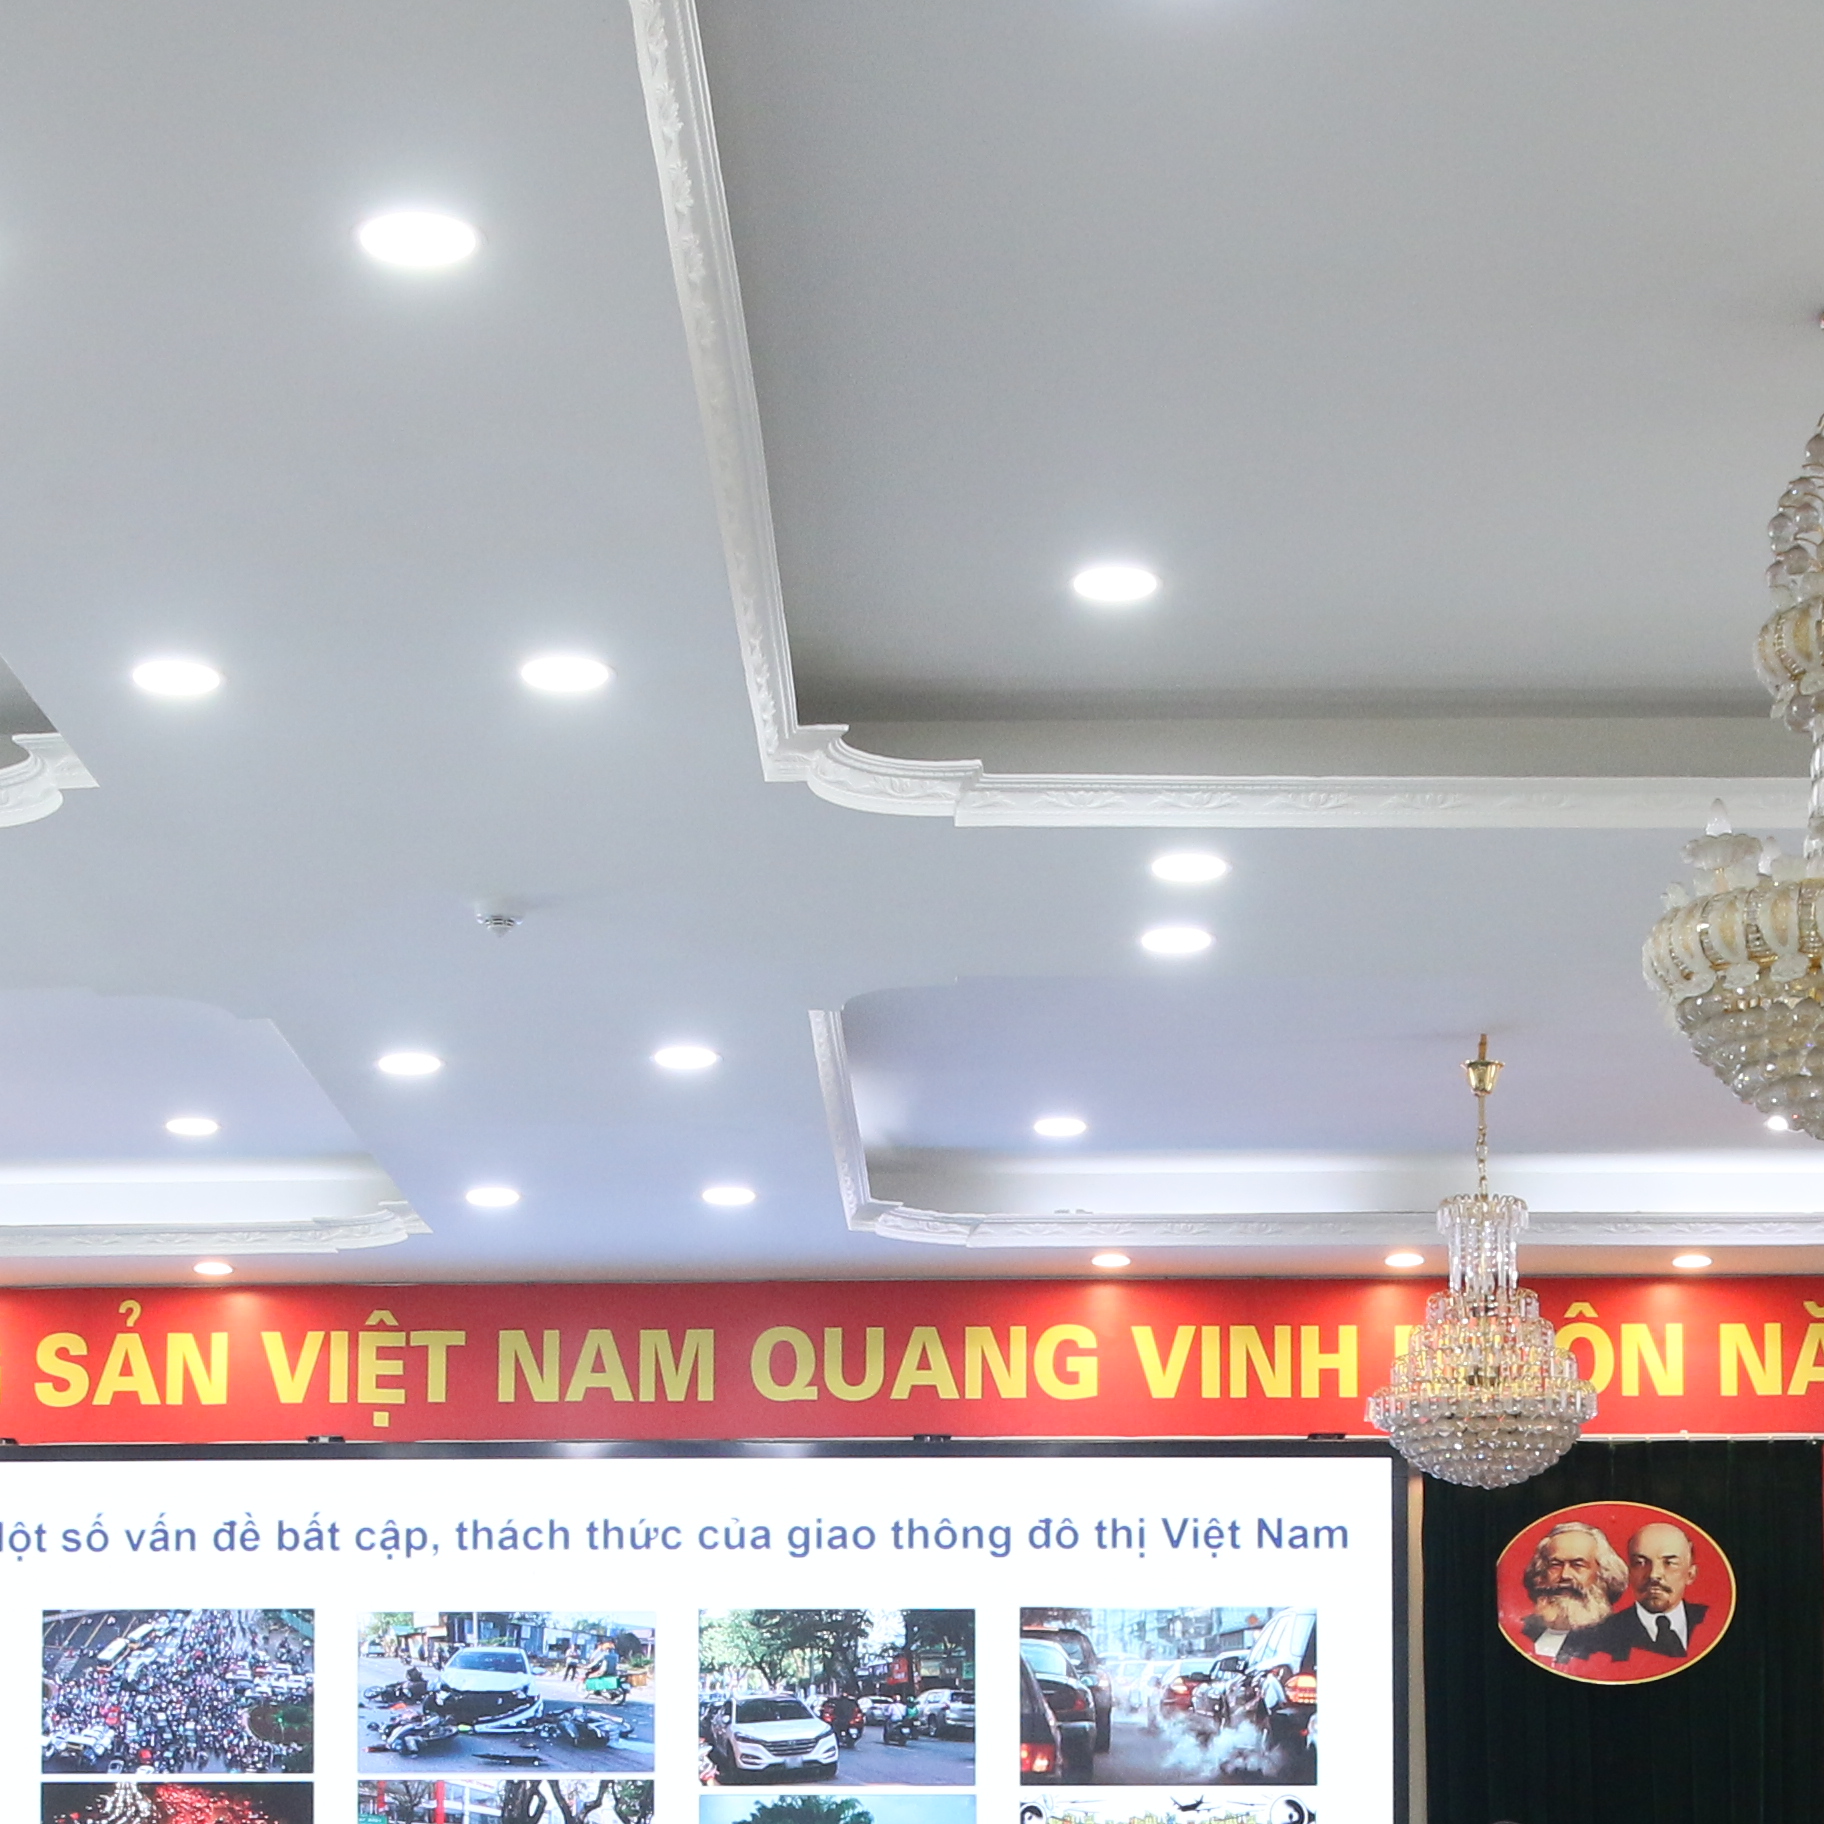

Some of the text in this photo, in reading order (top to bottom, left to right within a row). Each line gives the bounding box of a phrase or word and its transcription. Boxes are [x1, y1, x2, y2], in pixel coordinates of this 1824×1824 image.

[34, 1300, 231, 1407] SẢN
[261, 1311, 465, 1426] VIỆT
[499, 1330, 714, 1401] NAM
[753, 1323, 1100, 1400] QUANG
[1129, 1325, 1361, 1398] VINH
[61, 1512, 109, 1552] số
[124, 1512, 196, 1552] vấn
[213, 1512, 260, 1552] đề
[277, 1511, 340, 1551] bất
[355, 1519, 439, 1560] cập,
[455, 1519, 569, 1550] thách
[586, 1518, 682, 1550] thức
[698, 1517, 771, 1550] của
[787, 1518, 876, 1558] giao
[891, 1518, 1011, 1558] thông
[1028, 1518, 1079, 1549] đô
[1094, 1518, 1145, 1558] thị
[1161, 1518, 1241, 1558] Việt
[1257, 1518, 1348, 1549] Nam
